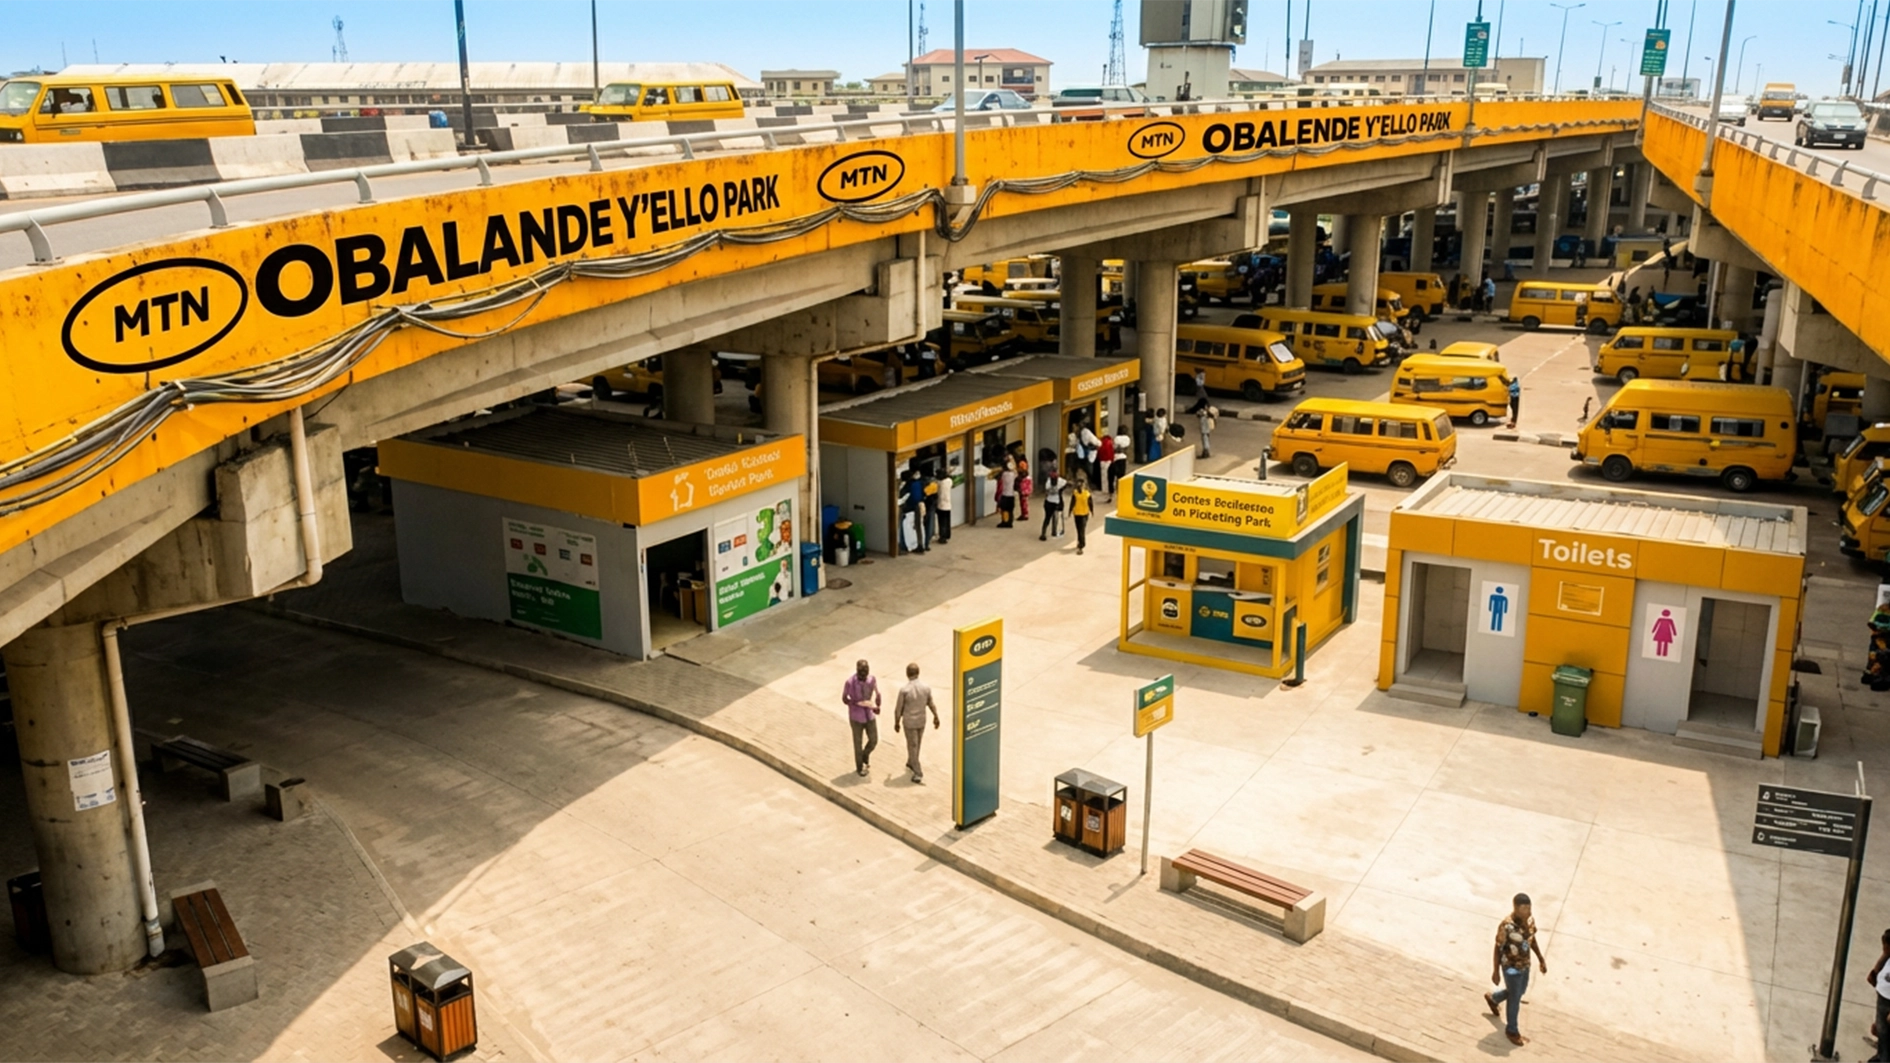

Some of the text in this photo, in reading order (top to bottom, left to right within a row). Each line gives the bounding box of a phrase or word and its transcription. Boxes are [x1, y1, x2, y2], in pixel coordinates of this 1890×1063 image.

[1141, 131, 1174, 150] MTN
[1202, 115, 1361, 154] OBALENDE
[1365, 113, 1417, 138] Y'ELLO
[840, 164, 888, 189] MTN
[255, 174, 781, 318] OBALANDE Y'ELLO PARK
[114, 286, 210, 343] MTN
[1538, 538, 1632, 570] Toilets
